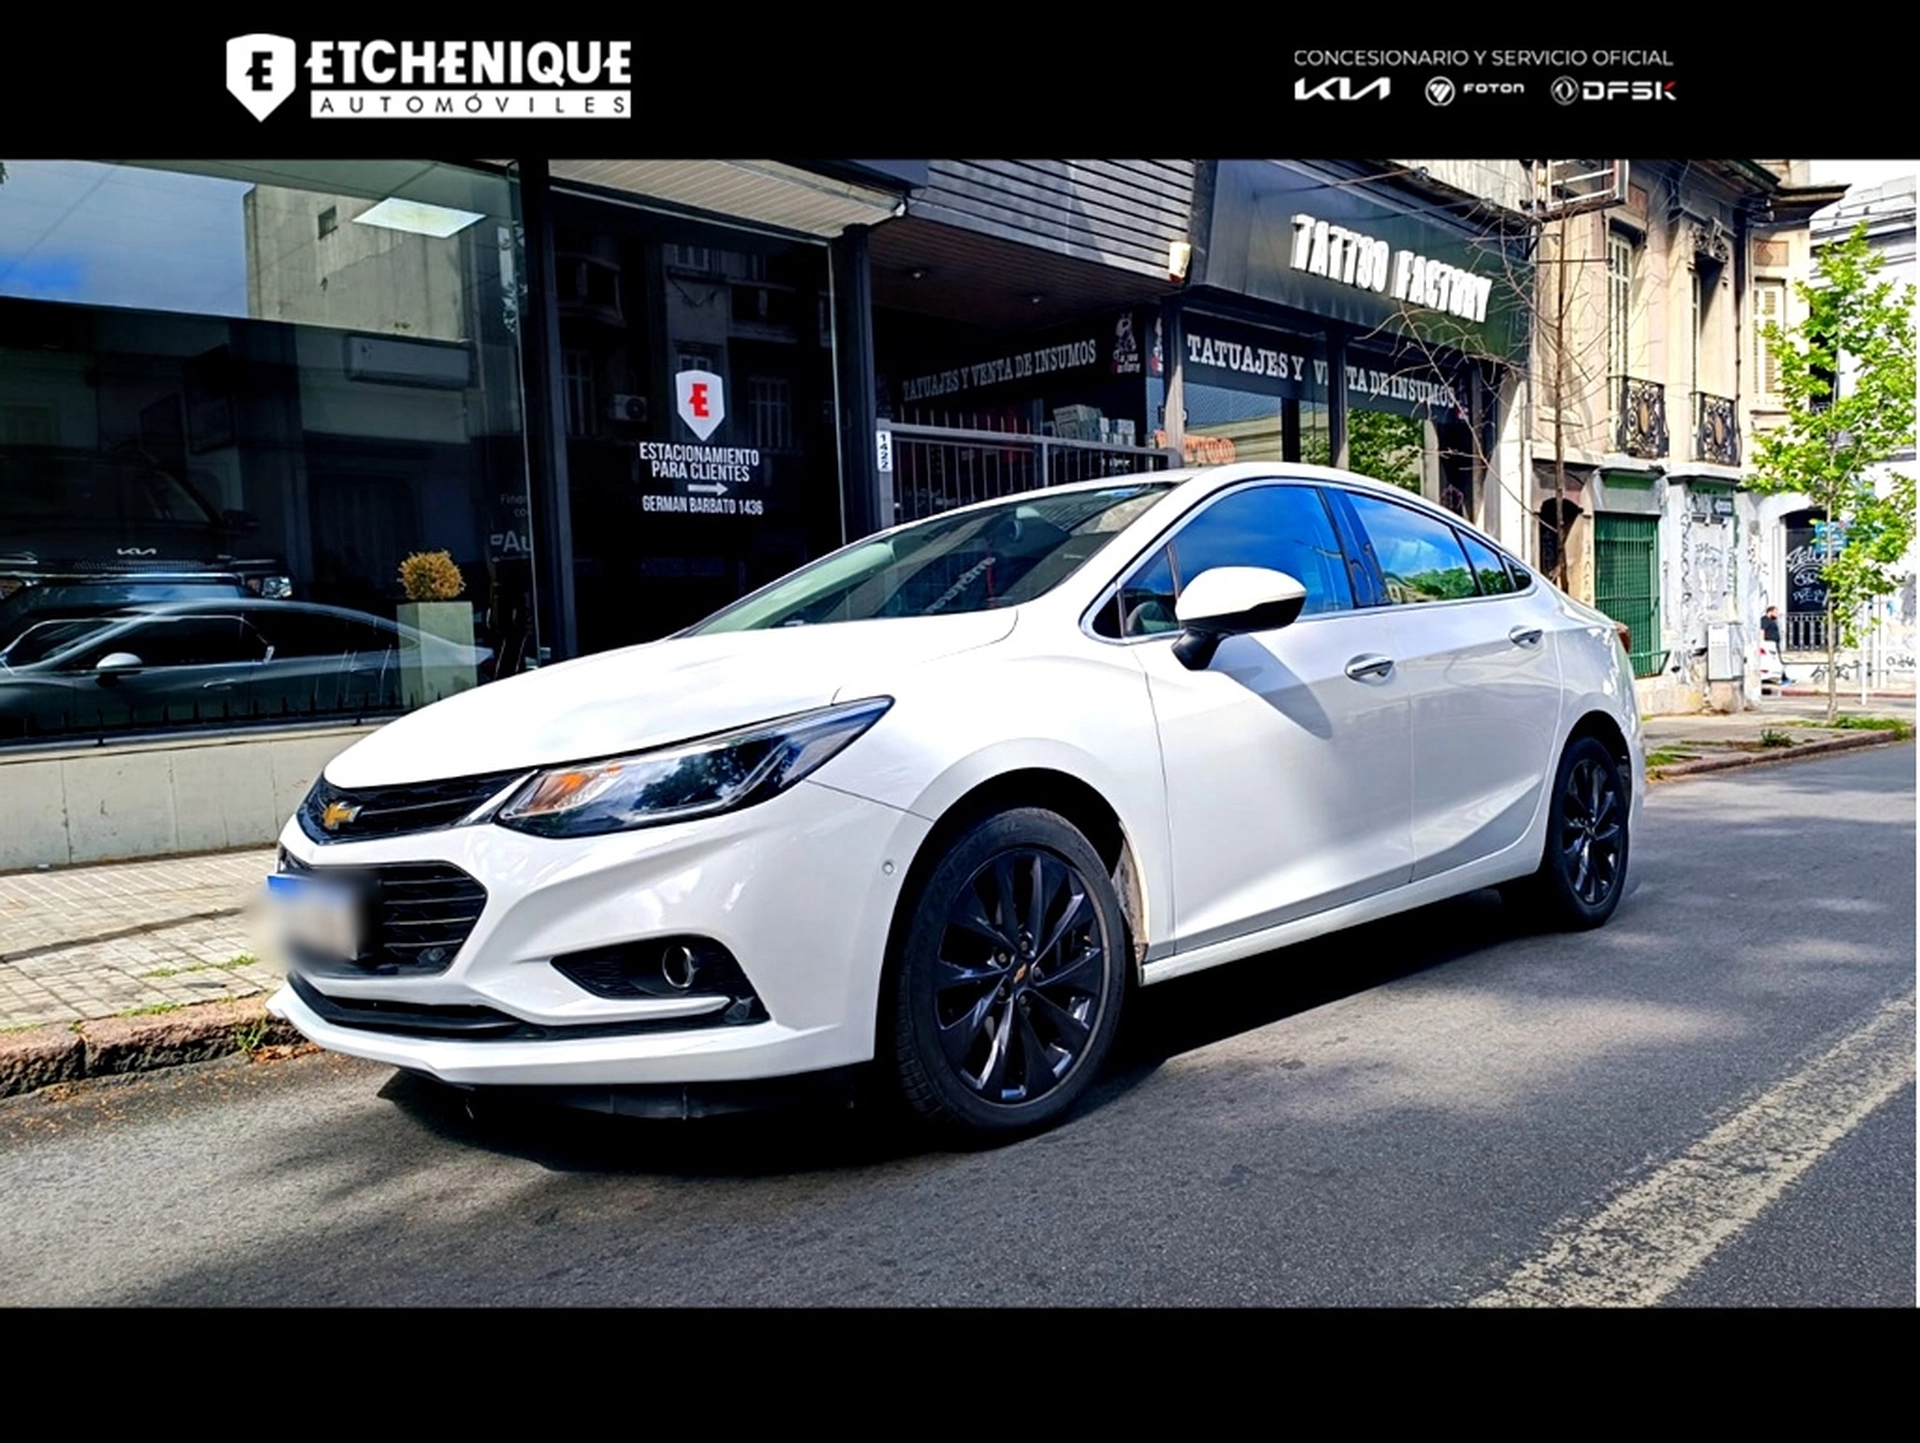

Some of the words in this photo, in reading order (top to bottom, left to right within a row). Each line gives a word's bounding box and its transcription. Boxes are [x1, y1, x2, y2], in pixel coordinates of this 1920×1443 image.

[1291, 214, 1389, 293] TATTOO
[1392, 250, 1492, 323] FACTORY
[902, 365, 959, 401] TATUAJES
[958, 366, 970, 390] Y
[971, 356, 1014, 387] VENTA
[1015, 352, 1033, 378] DE
[1034, 338, 1097, 375] INSUMOS
[1187, 333, 1288, 380] TATUAJES
[1292, 356, 1305, 381] Y
[1369, 369, 1389, 396] DE
[1391, 374, 1456, 408] INSUMOS
[639, 441, 760, 467] ESTACIONAMIENTO
[879, 433, 889, 469] 1422
[651, 460, 688, 479] PARA
[689, 462, 750, 482] CLIENTES
[642, 495, 688, 513] GERMAN
[689, 496, 736, 515] BARBATO
[738, 498, 764, 516] 1436
